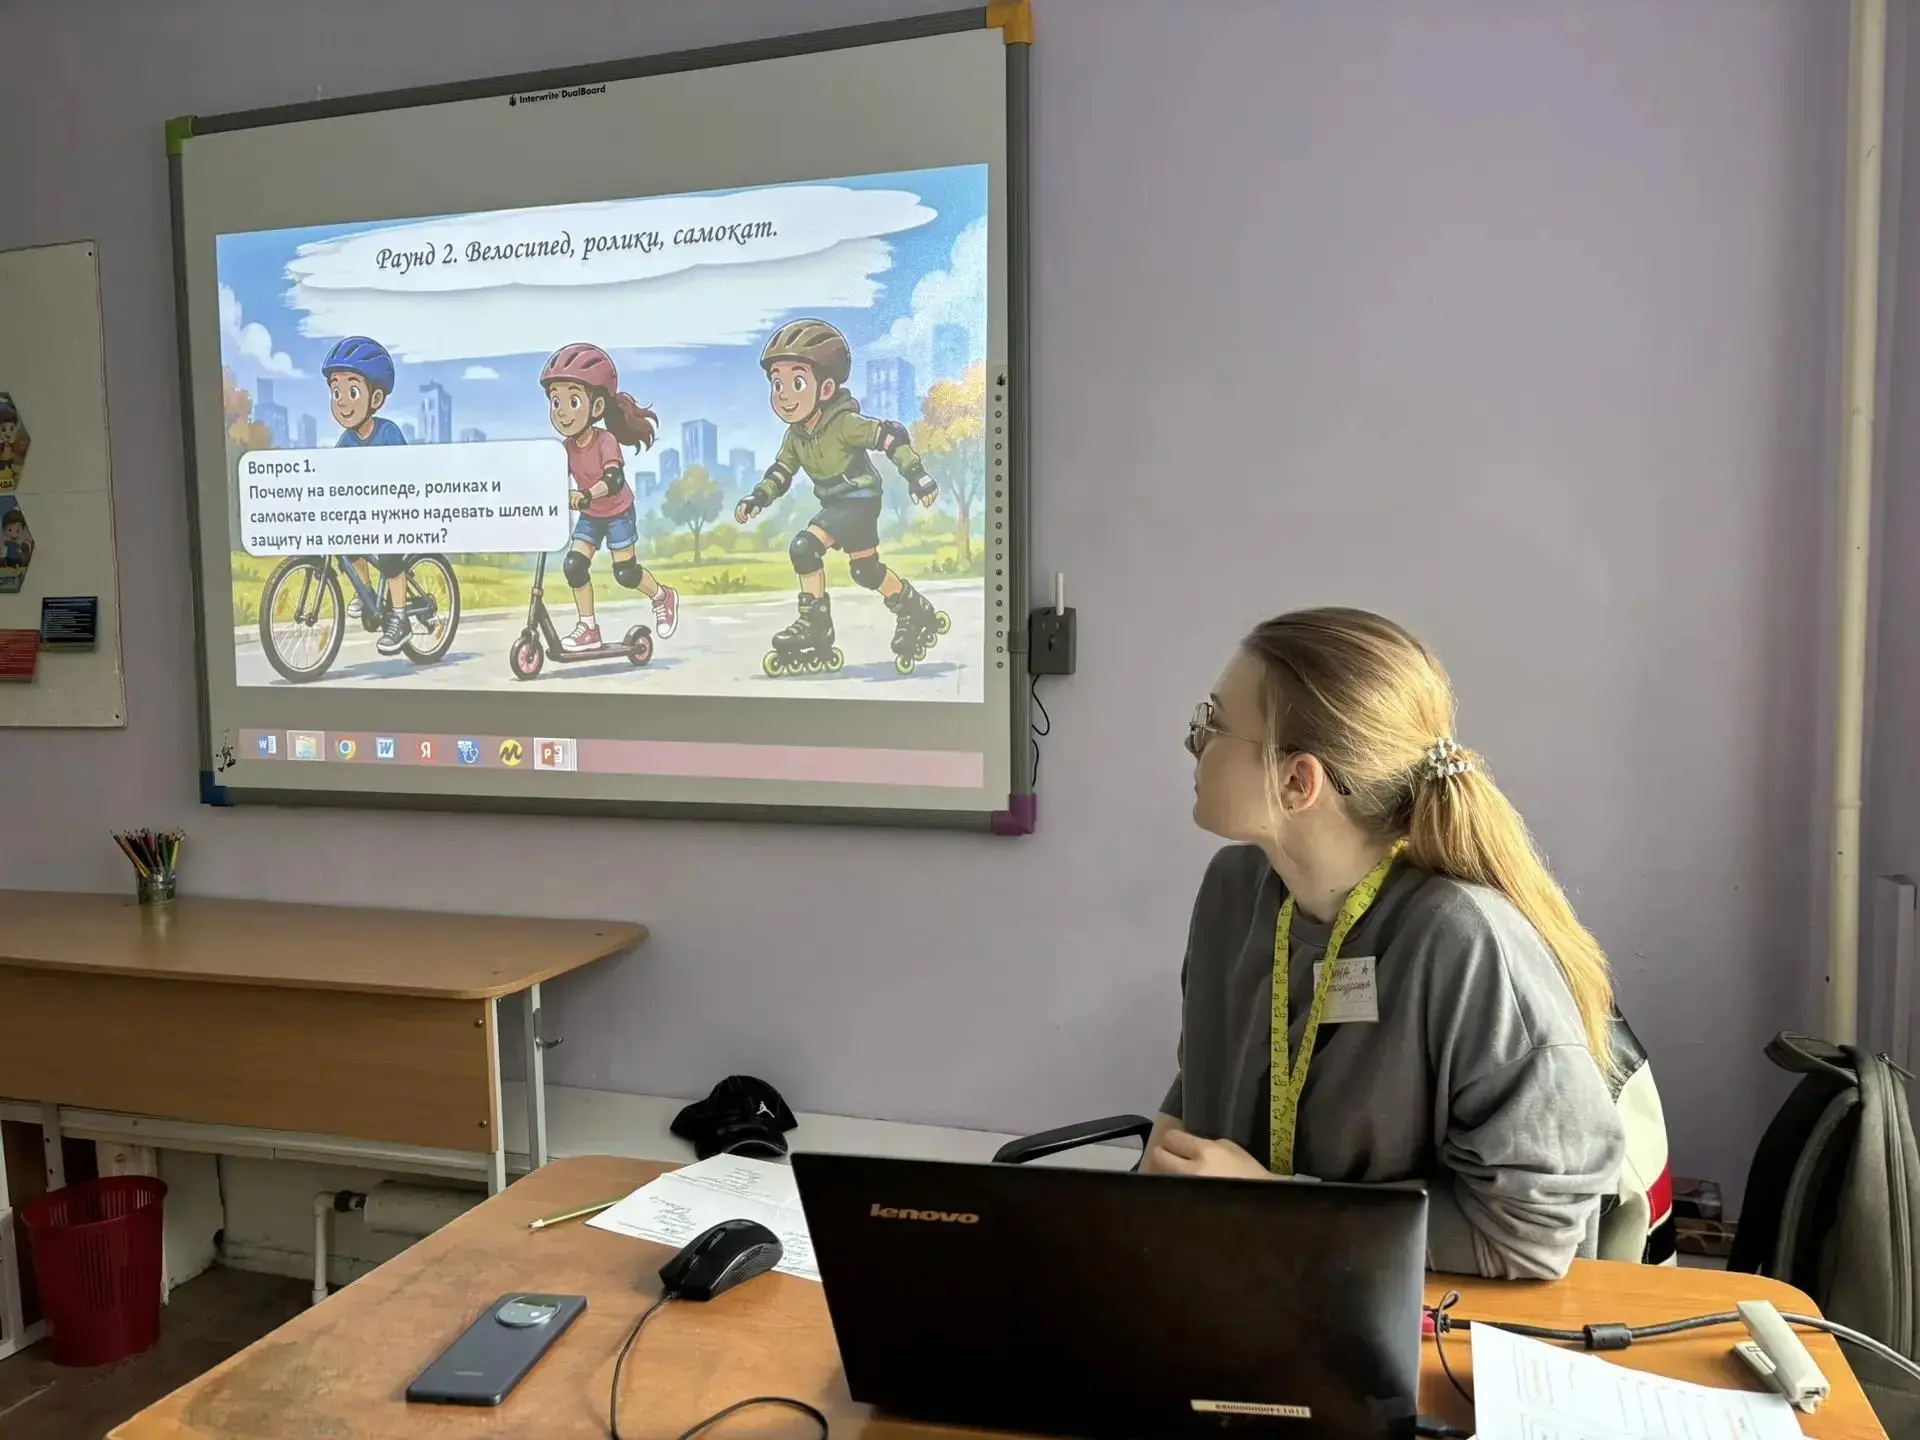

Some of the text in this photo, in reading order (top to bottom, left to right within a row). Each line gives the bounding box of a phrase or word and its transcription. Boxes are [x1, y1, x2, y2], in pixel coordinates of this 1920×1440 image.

[562, 84, 606, 98] DualBoard
[376, 221, 777, 275] Раунд 2. Велосипед, ролики, самокат.
[249, 459, 315, 478] Вопрос 1.
[250, 481, 500, 502] Почему на велосипеде, роликах и
[251, 506, 558, 524] самокате всегда нужно надевать шлем и
[251, 528, 447, 550] защиту на колени и локти?
[870, 1203, 980, 1224] lenovo
